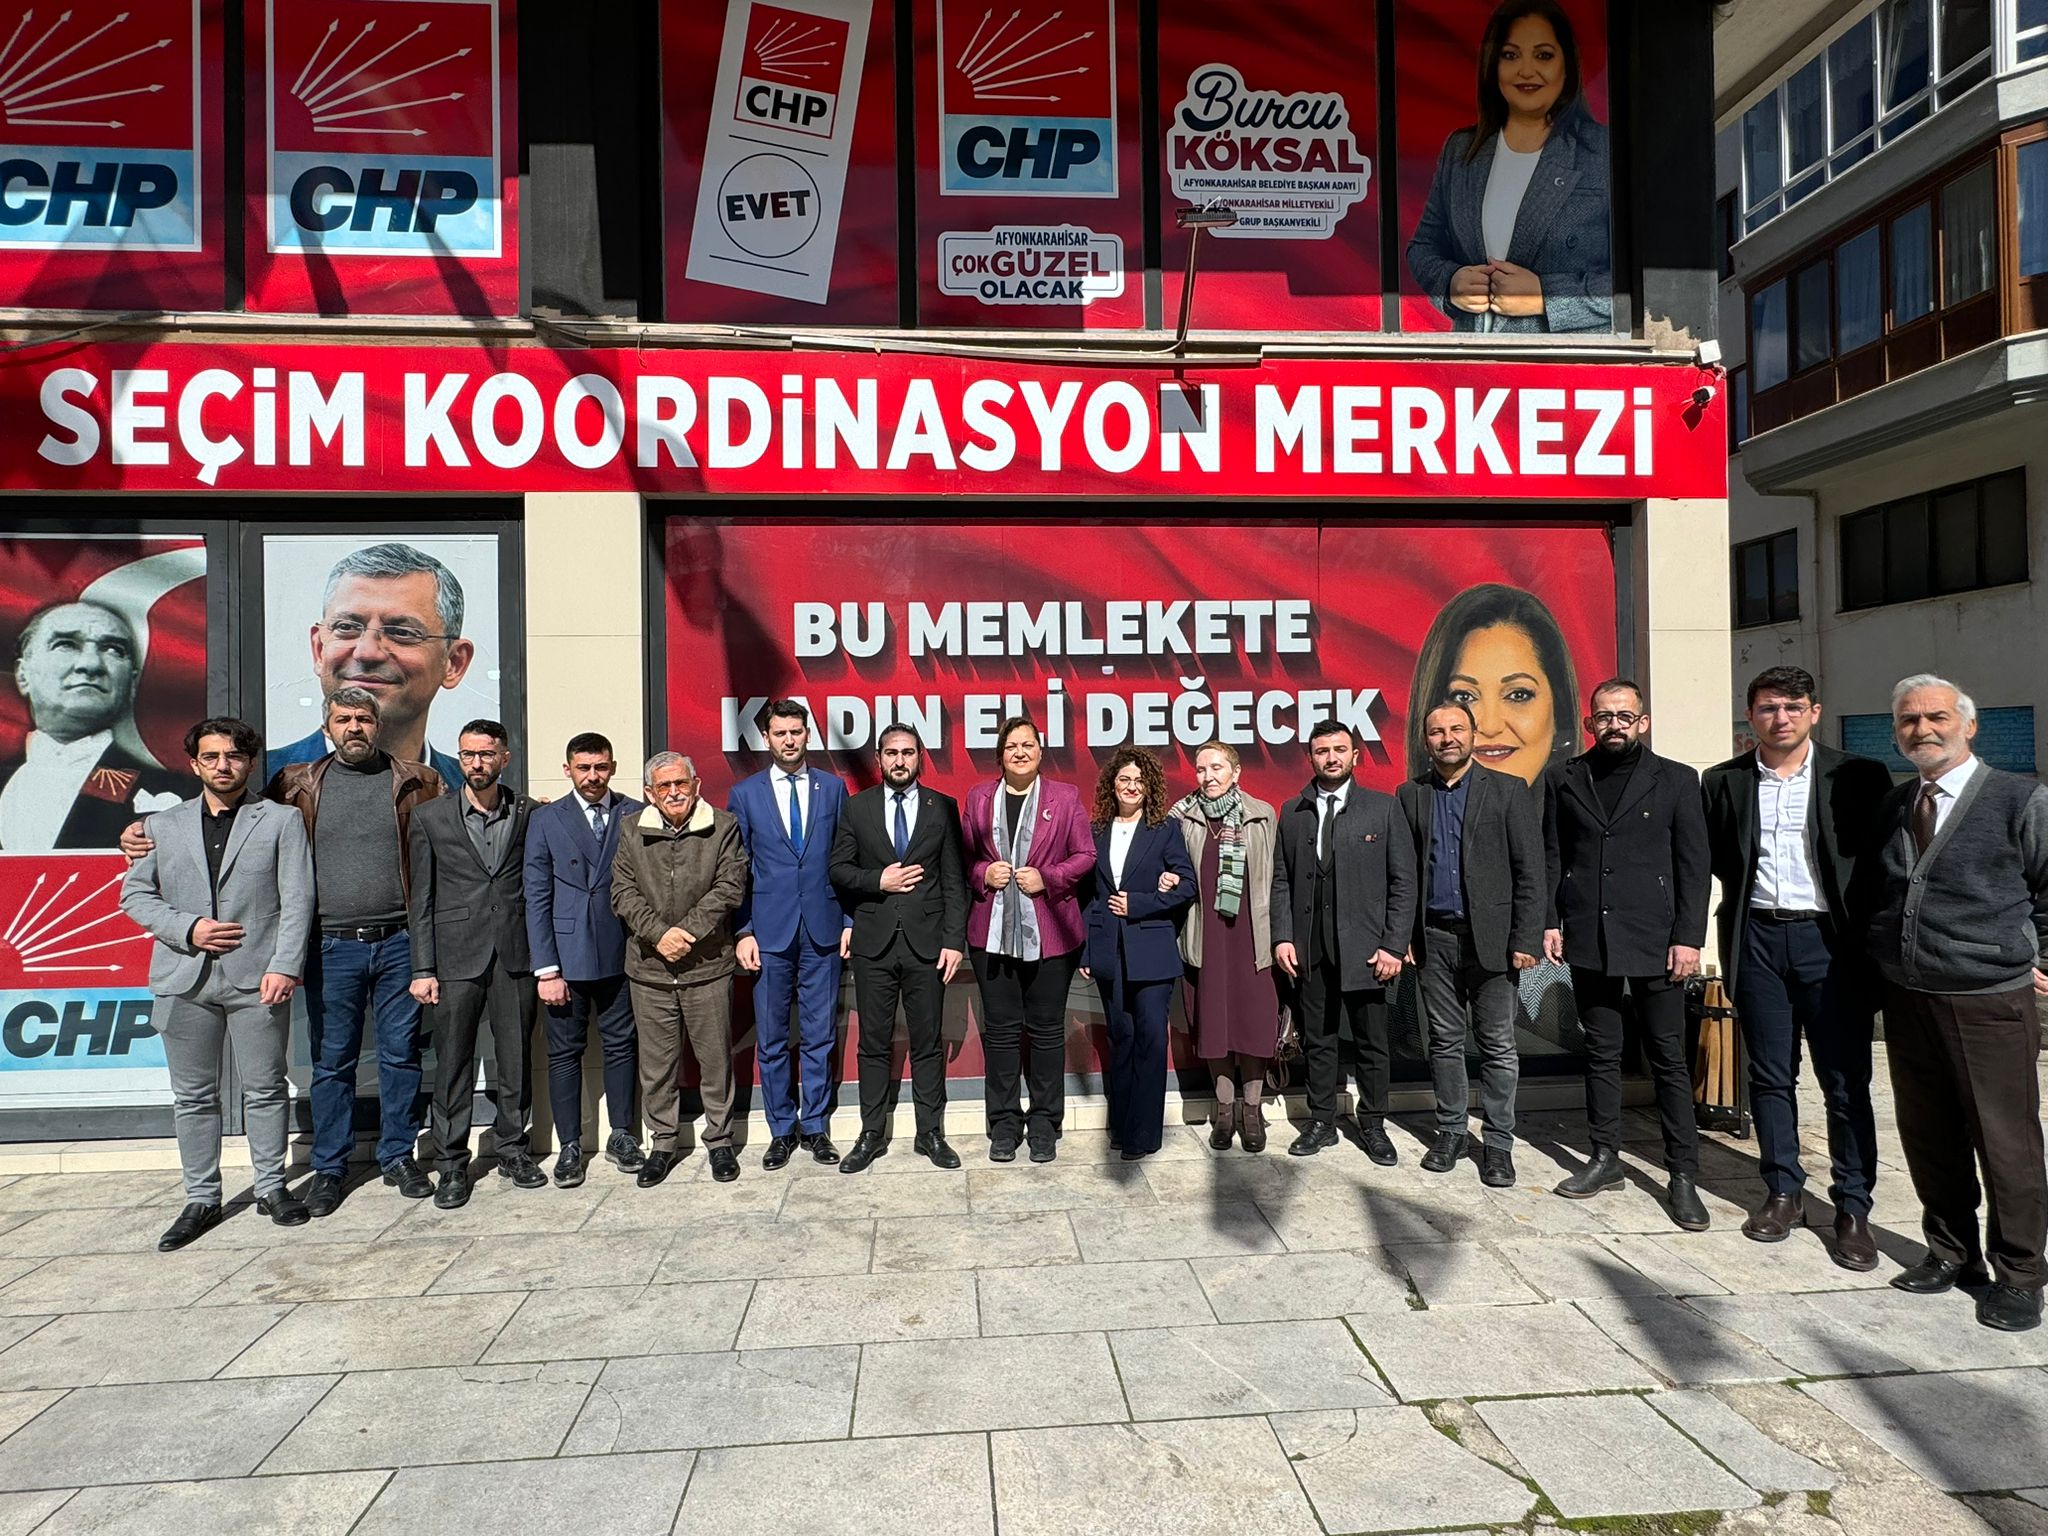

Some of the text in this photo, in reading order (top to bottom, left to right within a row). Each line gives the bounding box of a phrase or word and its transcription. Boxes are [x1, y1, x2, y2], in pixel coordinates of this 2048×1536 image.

[746, 85, 827, 126] CHP
[1182, 70, 1341, 132] Burcu
[956, 126, 1100, 179] CHP
[1174, 130, 1364, 174] KÖKSAL
[0, 159, 178, 227] CHP
[290, 166, 478, 232] CHP
[726, 190, 810, 221] EVET
[1184, 177, 1356, 191] AFYONKARAHİSAR BELEDİYE BAŞKAN ADAYI
[1282, 196, 1334, 209] MİLLETVEKİLİ
[995, 229, 1088, 247] AFYONKARAHİSAR
[1239, 217, 1321, 228] GRUP BAŞKANVEKİLİ
[952, 248, 1110, 278] ÇOK GÜZEL
[980, 280, 1084, 299] OLACAK
[37, 367, 1653, 486] SEÇİM KOORDİNASYON MERKEZİ
[793, 599, 1311, 657] BU MEMLEKETE
[1086, 676, 1381, 747] DEĞECEK
[2, 1000, 160, 1059] CHP
